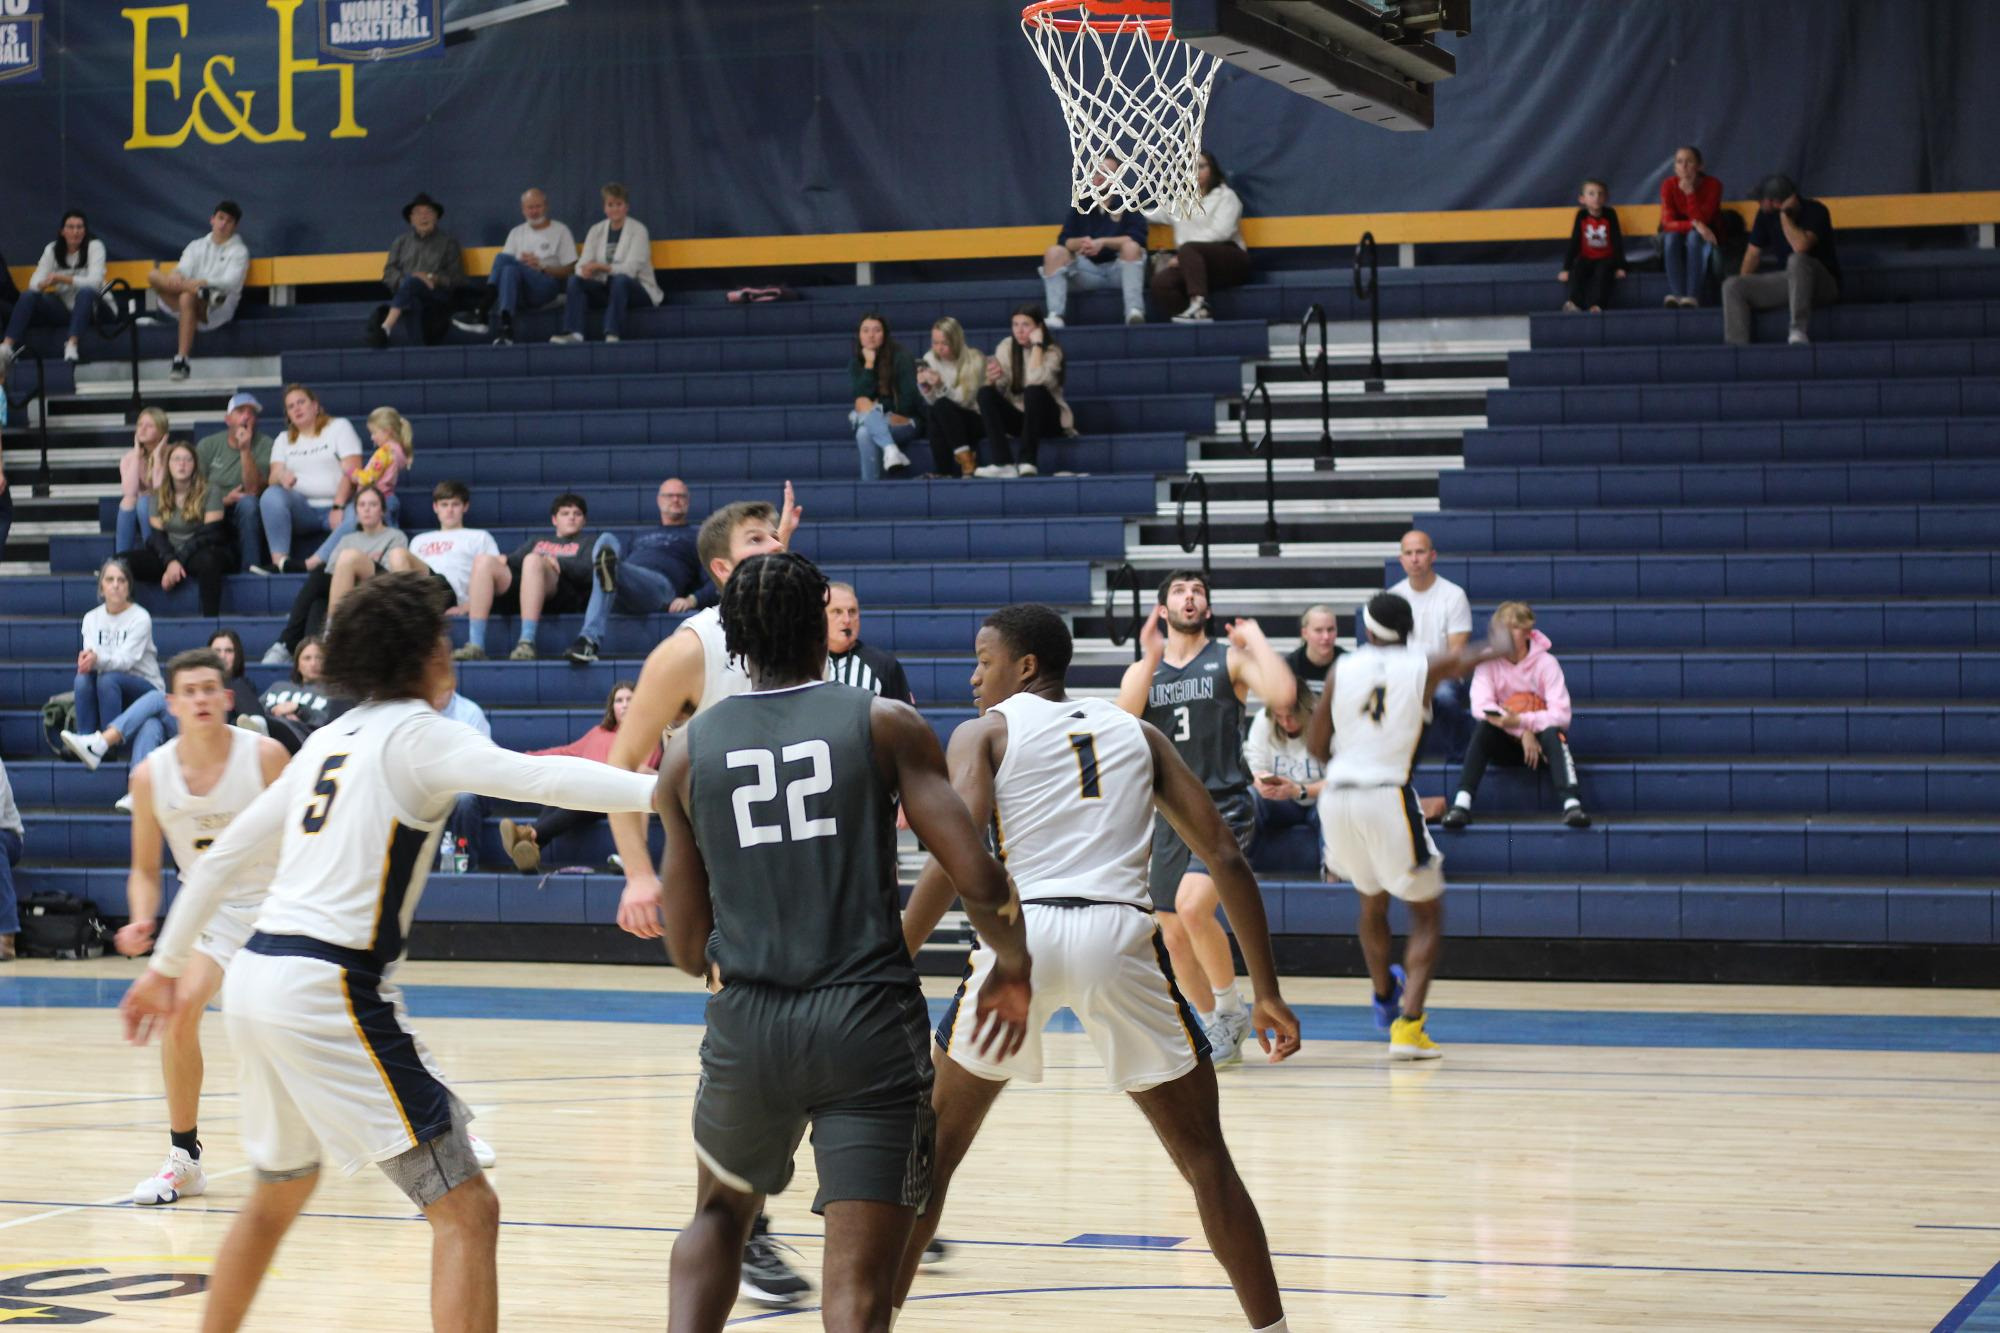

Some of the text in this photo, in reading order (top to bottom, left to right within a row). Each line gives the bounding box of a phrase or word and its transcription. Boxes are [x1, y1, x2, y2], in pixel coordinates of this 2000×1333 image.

[340, 0, 419, 21] WOMEN'S
[331, 16, 430, 44] BASKETBALL
[1149, 676, 1214, 708] LINCOLN
[1360, 683, 1387, 724] 4
[1174, 706, 1190, 742] 3
[1067, 731, 1102, 799] 1
[301, 752, 350, 835] 5
[726, 739, 837, 849] 22
